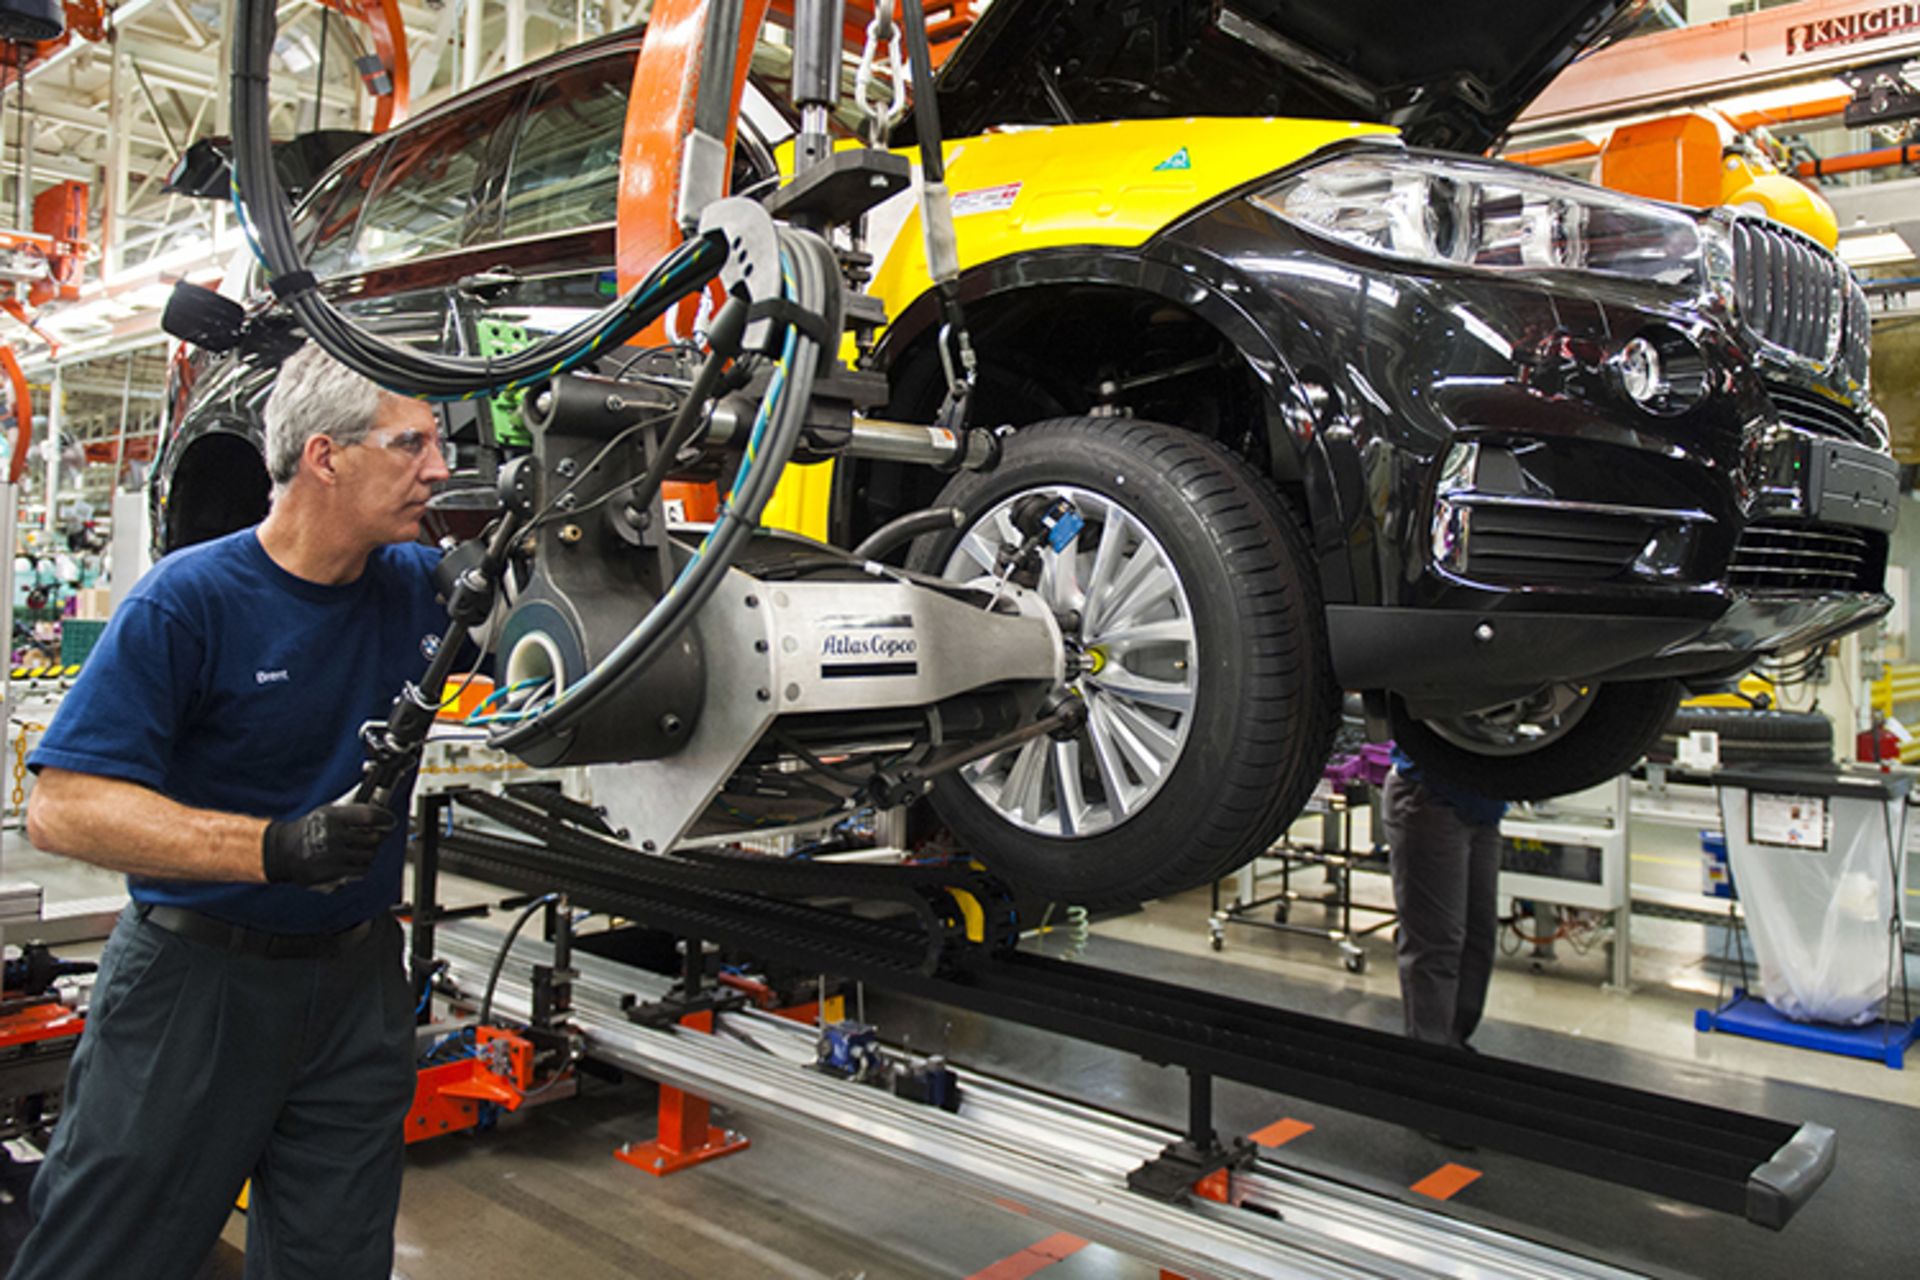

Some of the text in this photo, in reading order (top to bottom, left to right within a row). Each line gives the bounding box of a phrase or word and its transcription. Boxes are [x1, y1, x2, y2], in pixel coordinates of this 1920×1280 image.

[822, 634, 917, 658] Atlas Copco
[255, 669, 289, 684] Brent
